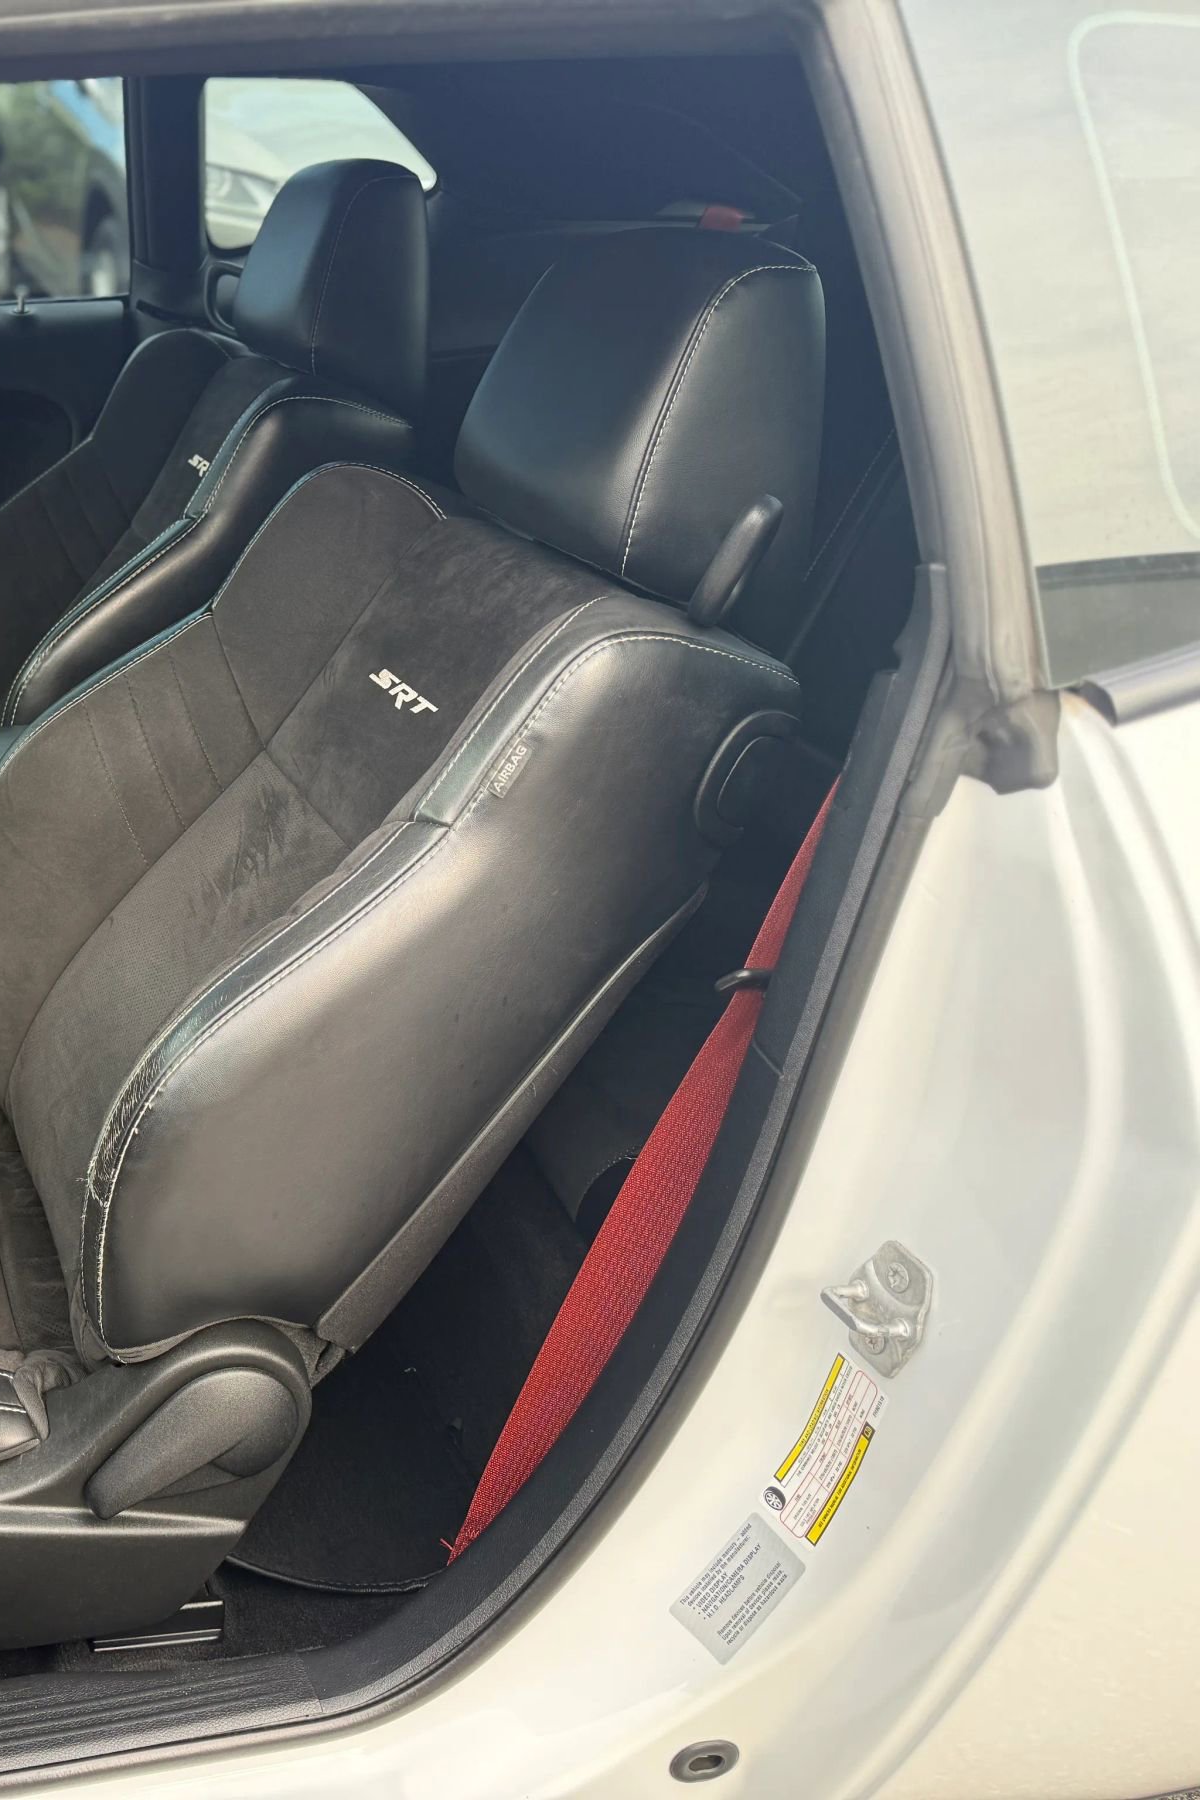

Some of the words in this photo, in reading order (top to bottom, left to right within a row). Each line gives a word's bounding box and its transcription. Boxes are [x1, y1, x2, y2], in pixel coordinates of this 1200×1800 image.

[187, 453, 211, 478] SR
[368, 668, 439, 714] SRT
[492, 744, 527, 792] AIRBAG
[696, 1592, 711, 1607] VIDEO
[708, 1572, 728, 1593] DISPLAY
[701, 1564, 745, 1613] NAVIGATION/CAMERA
[743, 1543, 760, 1565] DISPLAY
[718, 1575, 744, 1604] HEADLAMPS
